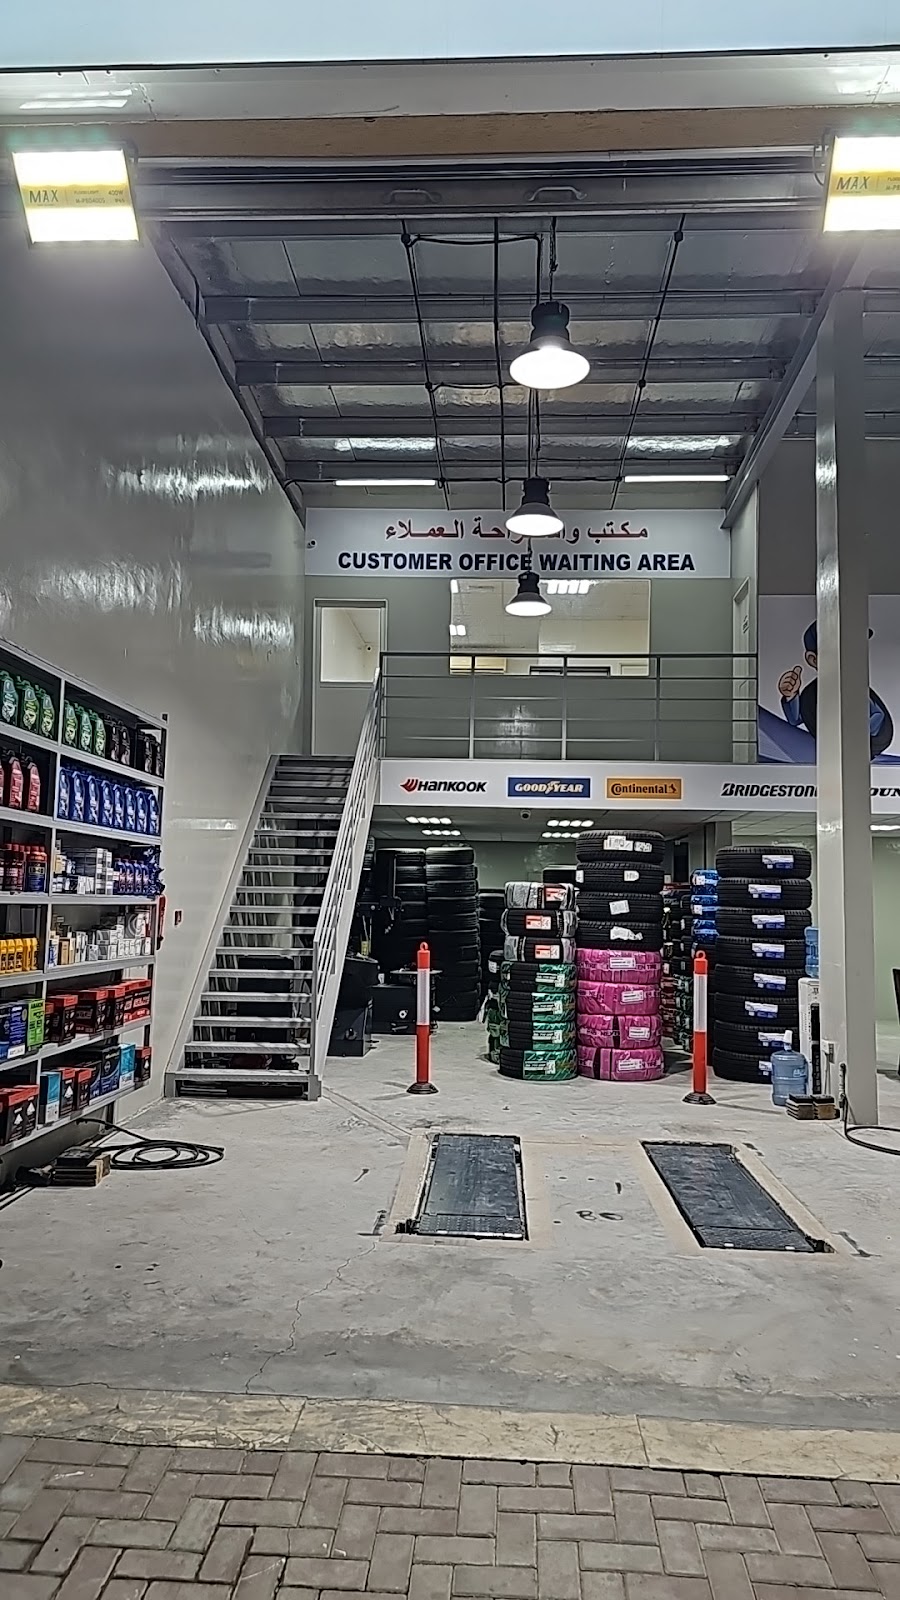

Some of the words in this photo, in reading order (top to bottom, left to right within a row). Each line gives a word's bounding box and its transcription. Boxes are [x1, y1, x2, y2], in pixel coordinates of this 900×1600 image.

[836, 176, 871, 190] MAX
[29, 189, 59, 203] MAX
[385, 519, 464, 540] العملاء
[587, 521, 649, 544] مكتب
[338, 552, 453, 570] CUSTOMER
[458, 553, 533, 571] OFFICE
[539, 554, 631, 571] WAITING
[637, 554, 696, 571] AREA
[514, 780, 584, 795] GOODYEAR
[610, 781, 668, 796] Continental
[721, 783, 818, 797] BRIDGESTON
